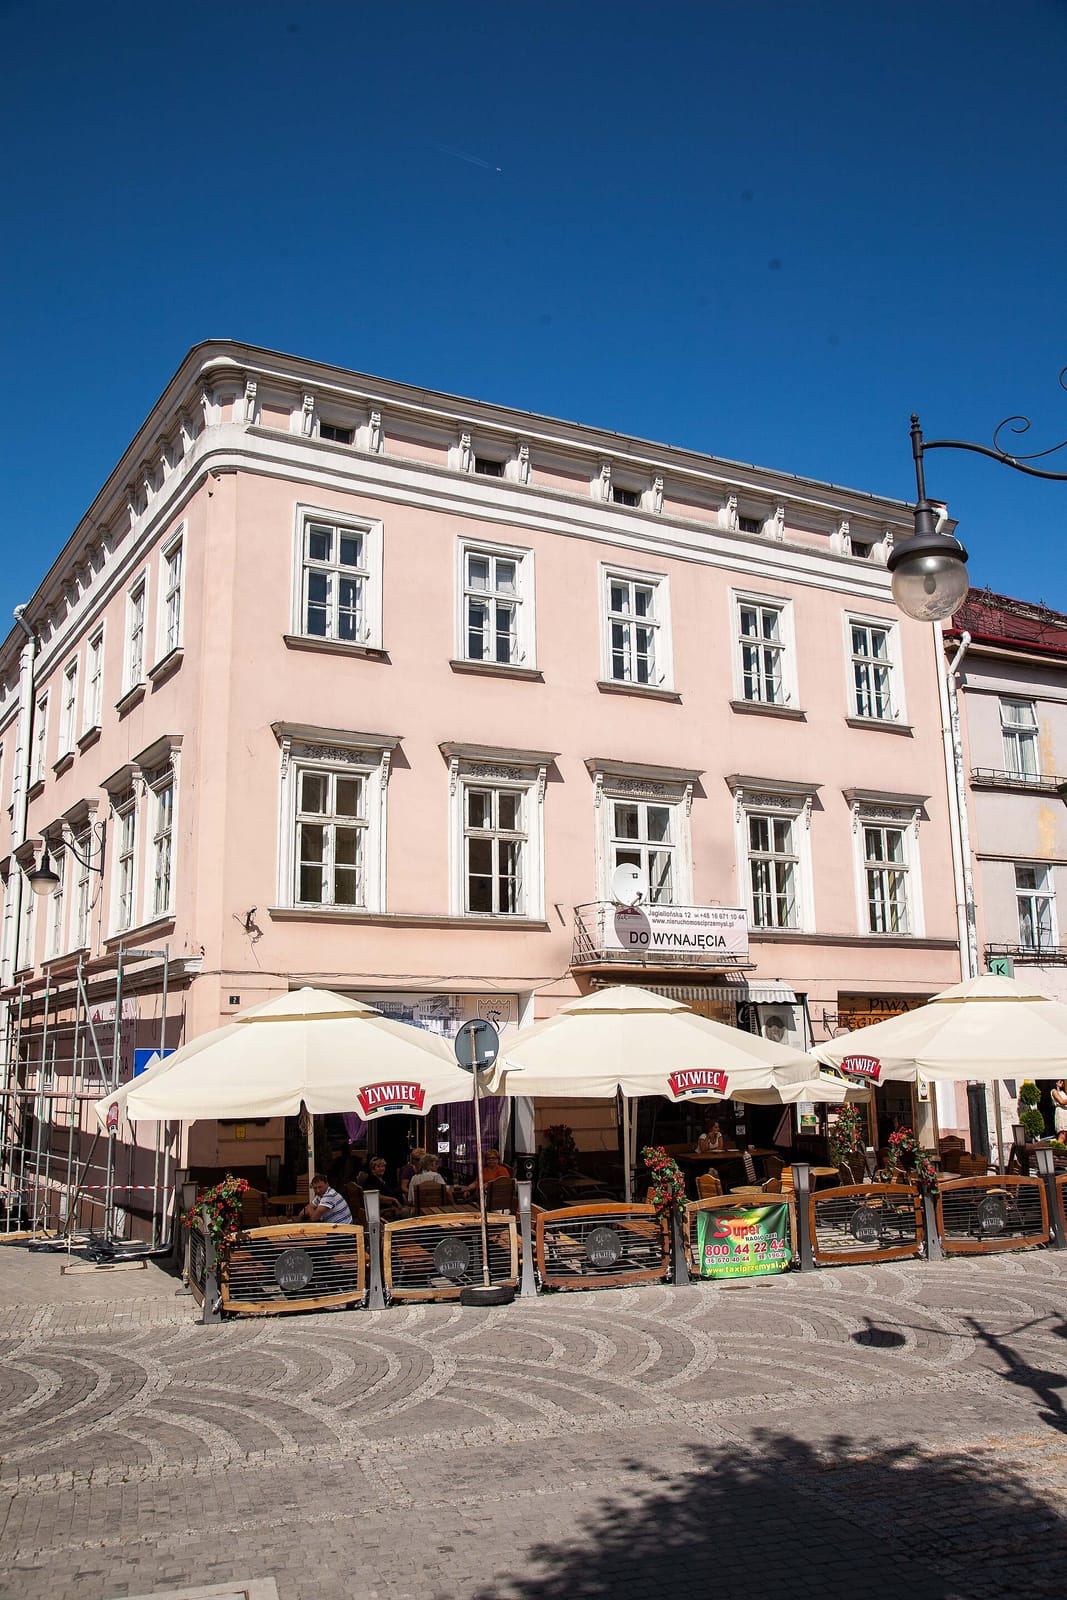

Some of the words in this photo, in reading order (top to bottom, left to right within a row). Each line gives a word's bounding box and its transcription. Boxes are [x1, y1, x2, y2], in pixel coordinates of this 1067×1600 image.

[648, 910, 683, 918] Jagiellońska
[630, 932, 649, 944] DO
[653, 932, 726, 950] WYNAJĘCIA
[870, 998, 910, 1012] PIWA
[845, 1057, 876, 1074] ŻYWIEC
[674, 1071, 720, 1088] ŻYWIEC
[365, 1085, 417, 1105] ŻYWIEC
[714, 1215, 762, 1239] Super
[706, 1245, 730, 1256] 800
[734, 1244, 750, 1254] 44
[754, 1242, 767, 1253] 22
[770, 1239, 785, 1250] 44
[706, 1260, 789, 1274] www.taxiprzemysl.pl
